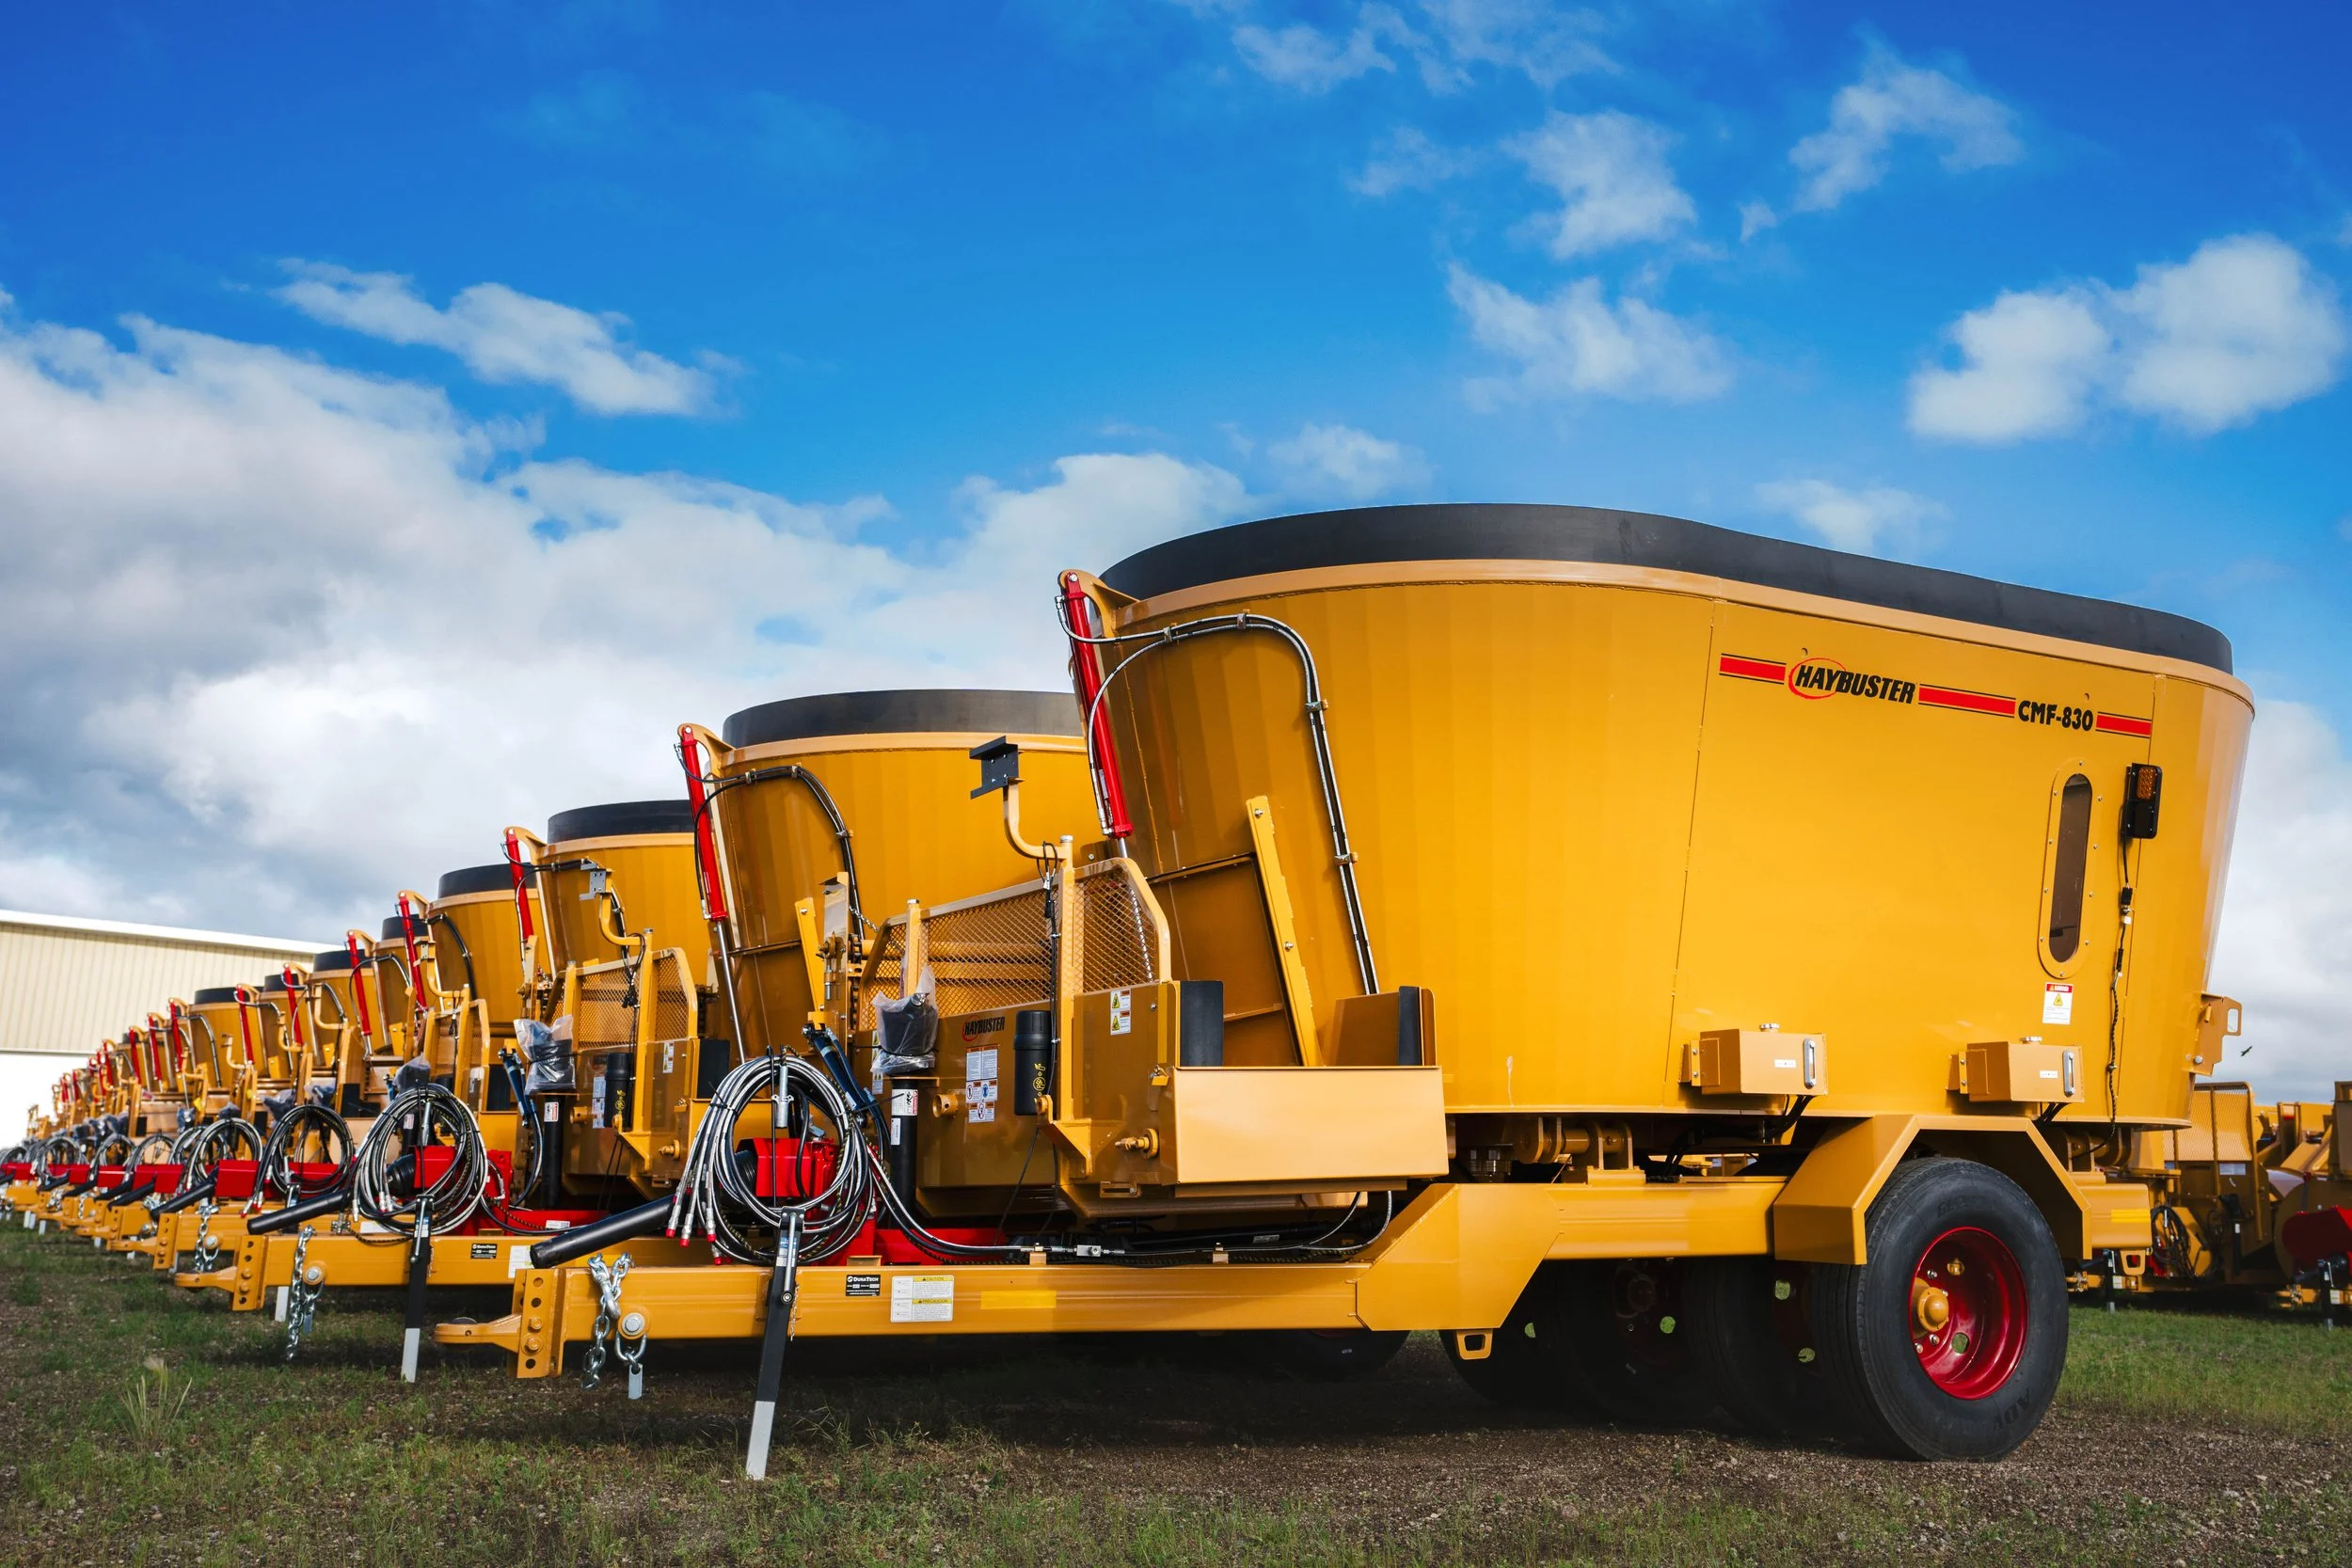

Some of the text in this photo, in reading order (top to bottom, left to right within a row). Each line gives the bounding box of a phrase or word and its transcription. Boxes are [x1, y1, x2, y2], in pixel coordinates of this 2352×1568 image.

[1795, 664, 1916, 705] HAYBUSTER
[2018, 700, 2094, 732] CMF-830
[964, 1017, 1006, 1036] HAYBUSTER
